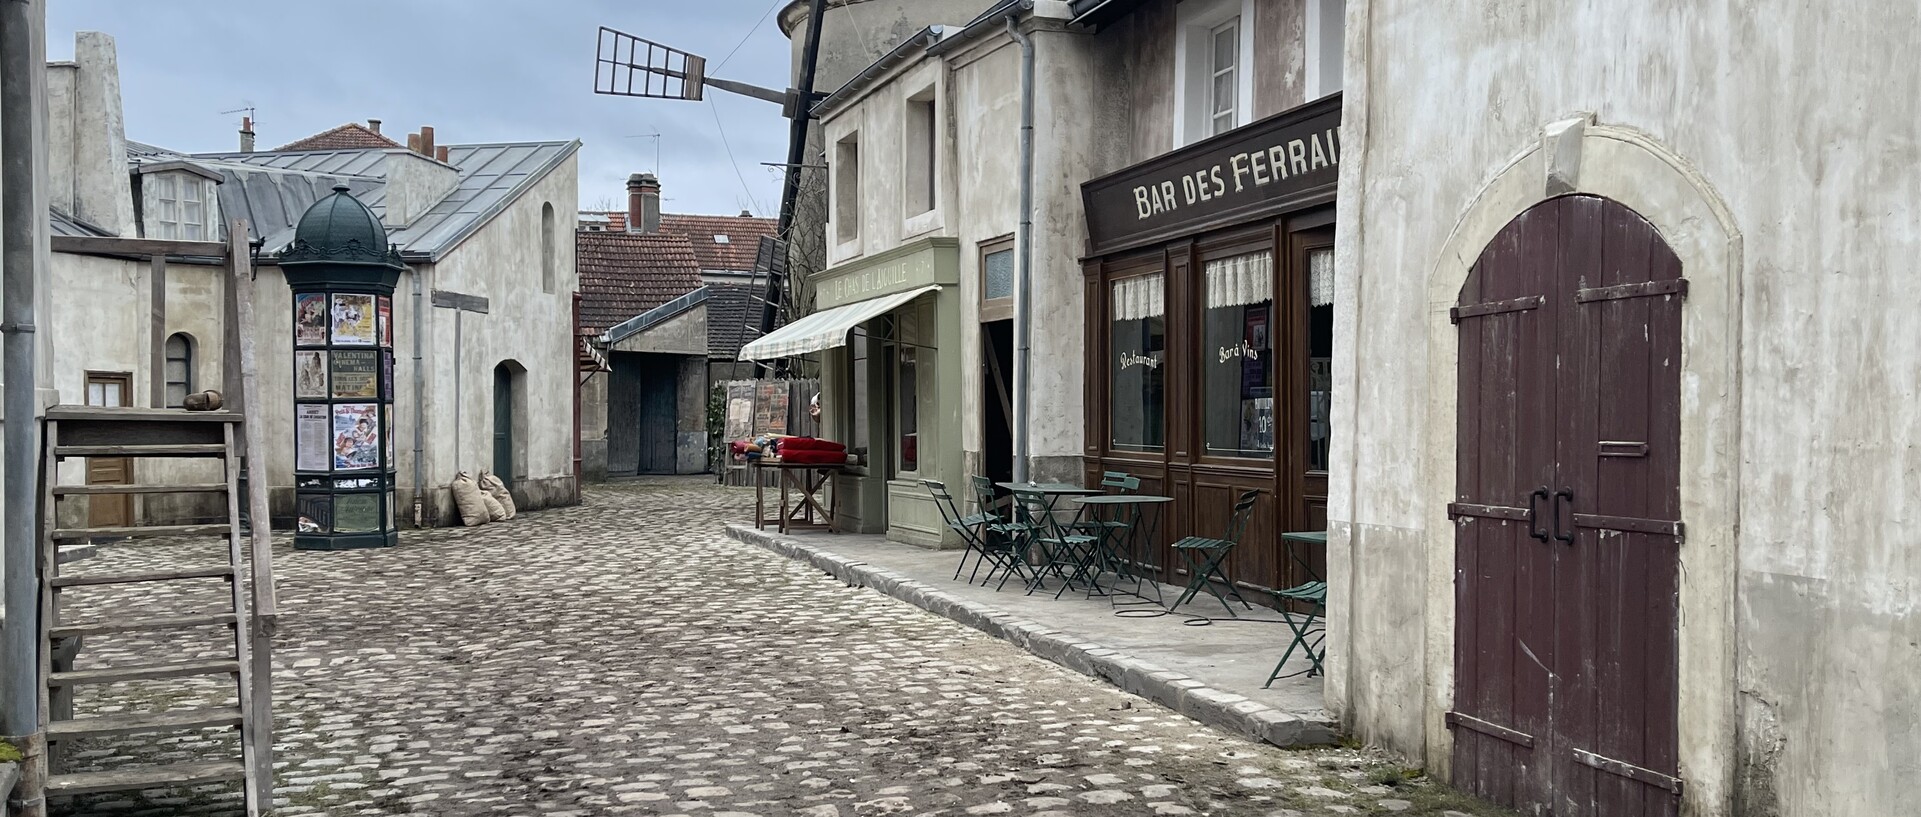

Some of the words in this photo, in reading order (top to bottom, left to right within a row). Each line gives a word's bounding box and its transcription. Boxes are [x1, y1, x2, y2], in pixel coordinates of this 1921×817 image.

[1132, 180, 1177, 220] BAR
[1182, 165, 1225, 206] DES
[1229, 126, 1341, 193] FERRAI
[834, 280, 842, 300] LE
[861, 273, 870, 292] DE
[1120, 349, 1157, 370] Restaurant
[1218, 346, 1233, 364] Bar
[1242, 339, 1258, 361] Vins
